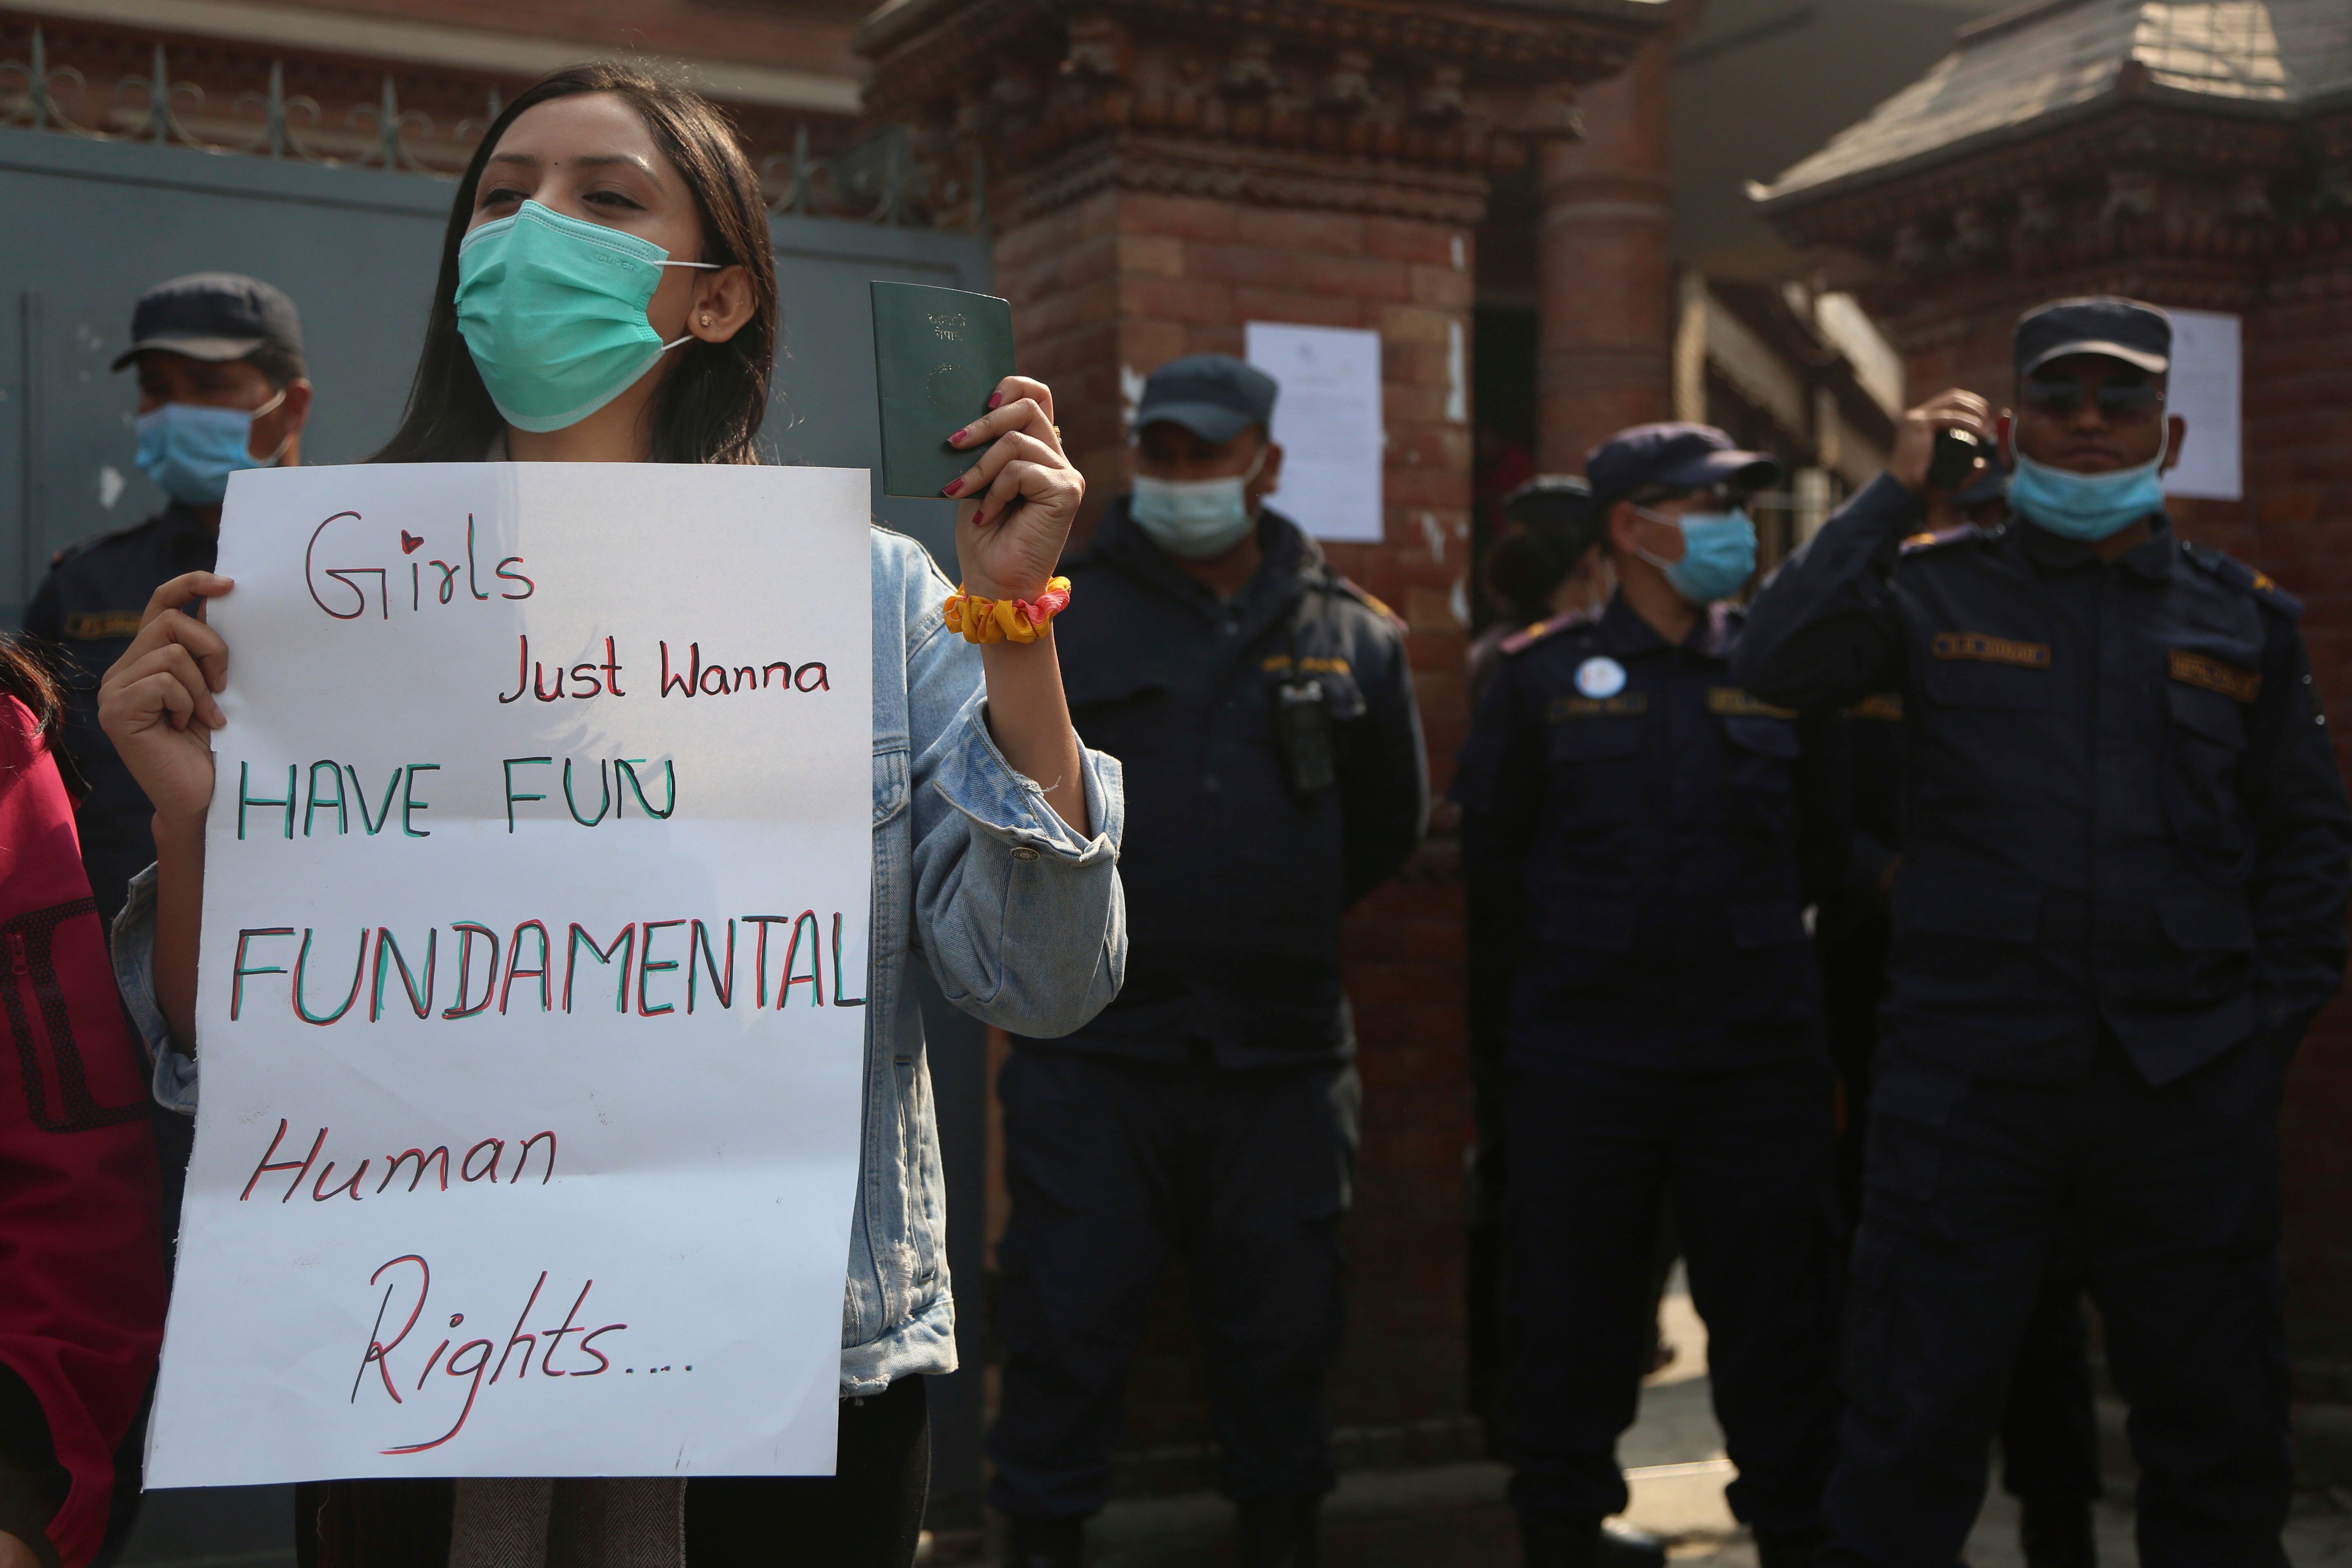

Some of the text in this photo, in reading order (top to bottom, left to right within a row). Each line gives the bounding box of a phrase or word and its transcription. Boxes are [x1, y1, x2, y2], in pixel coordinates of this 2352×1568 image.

[305, 510, 535, 620] Girls
[499, 634, 831, 704] Just Wanna
[237, 756, 676, 841] HAVE FUN
[230, 909, 867, 1027] FUNDAMENTAL
[239, 1118, 557, 1204] Human
